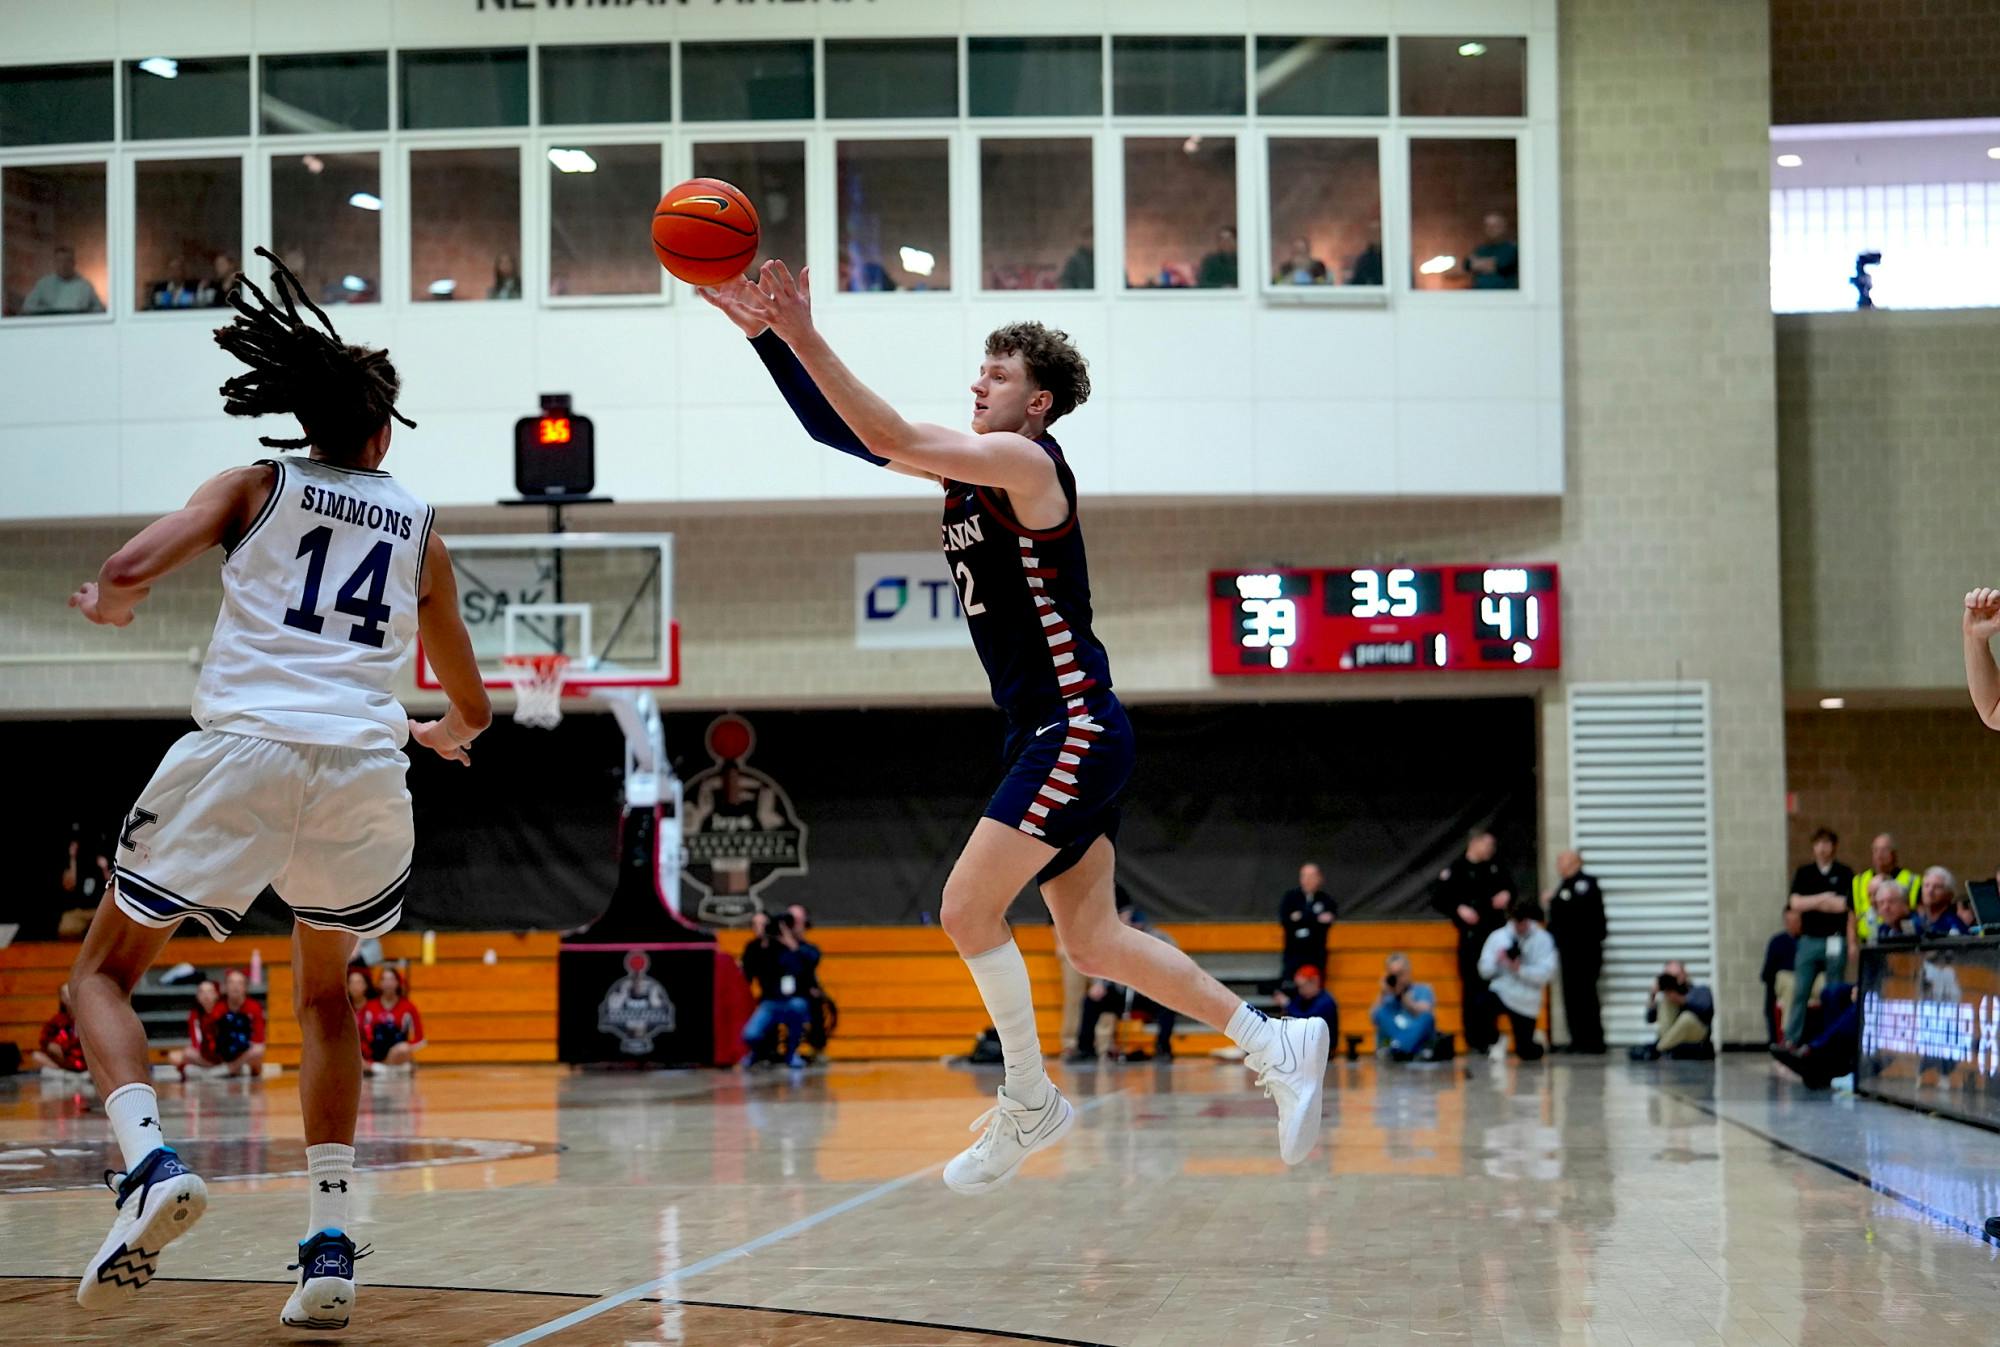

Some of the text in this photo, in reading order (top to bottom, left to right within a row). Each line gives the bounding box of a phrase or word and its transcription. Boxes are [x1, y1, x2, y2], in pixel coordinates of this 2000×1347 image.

[301, 485, 412, 540] SIMMONS
[283, 525, 393, 648] 14
[1351, 569, 1418, 617] 3.5
[1242, 599, 1296, 647] 39
[1482, 596, 1538, 640] 41
[1356, 641, 1413, 667] period
